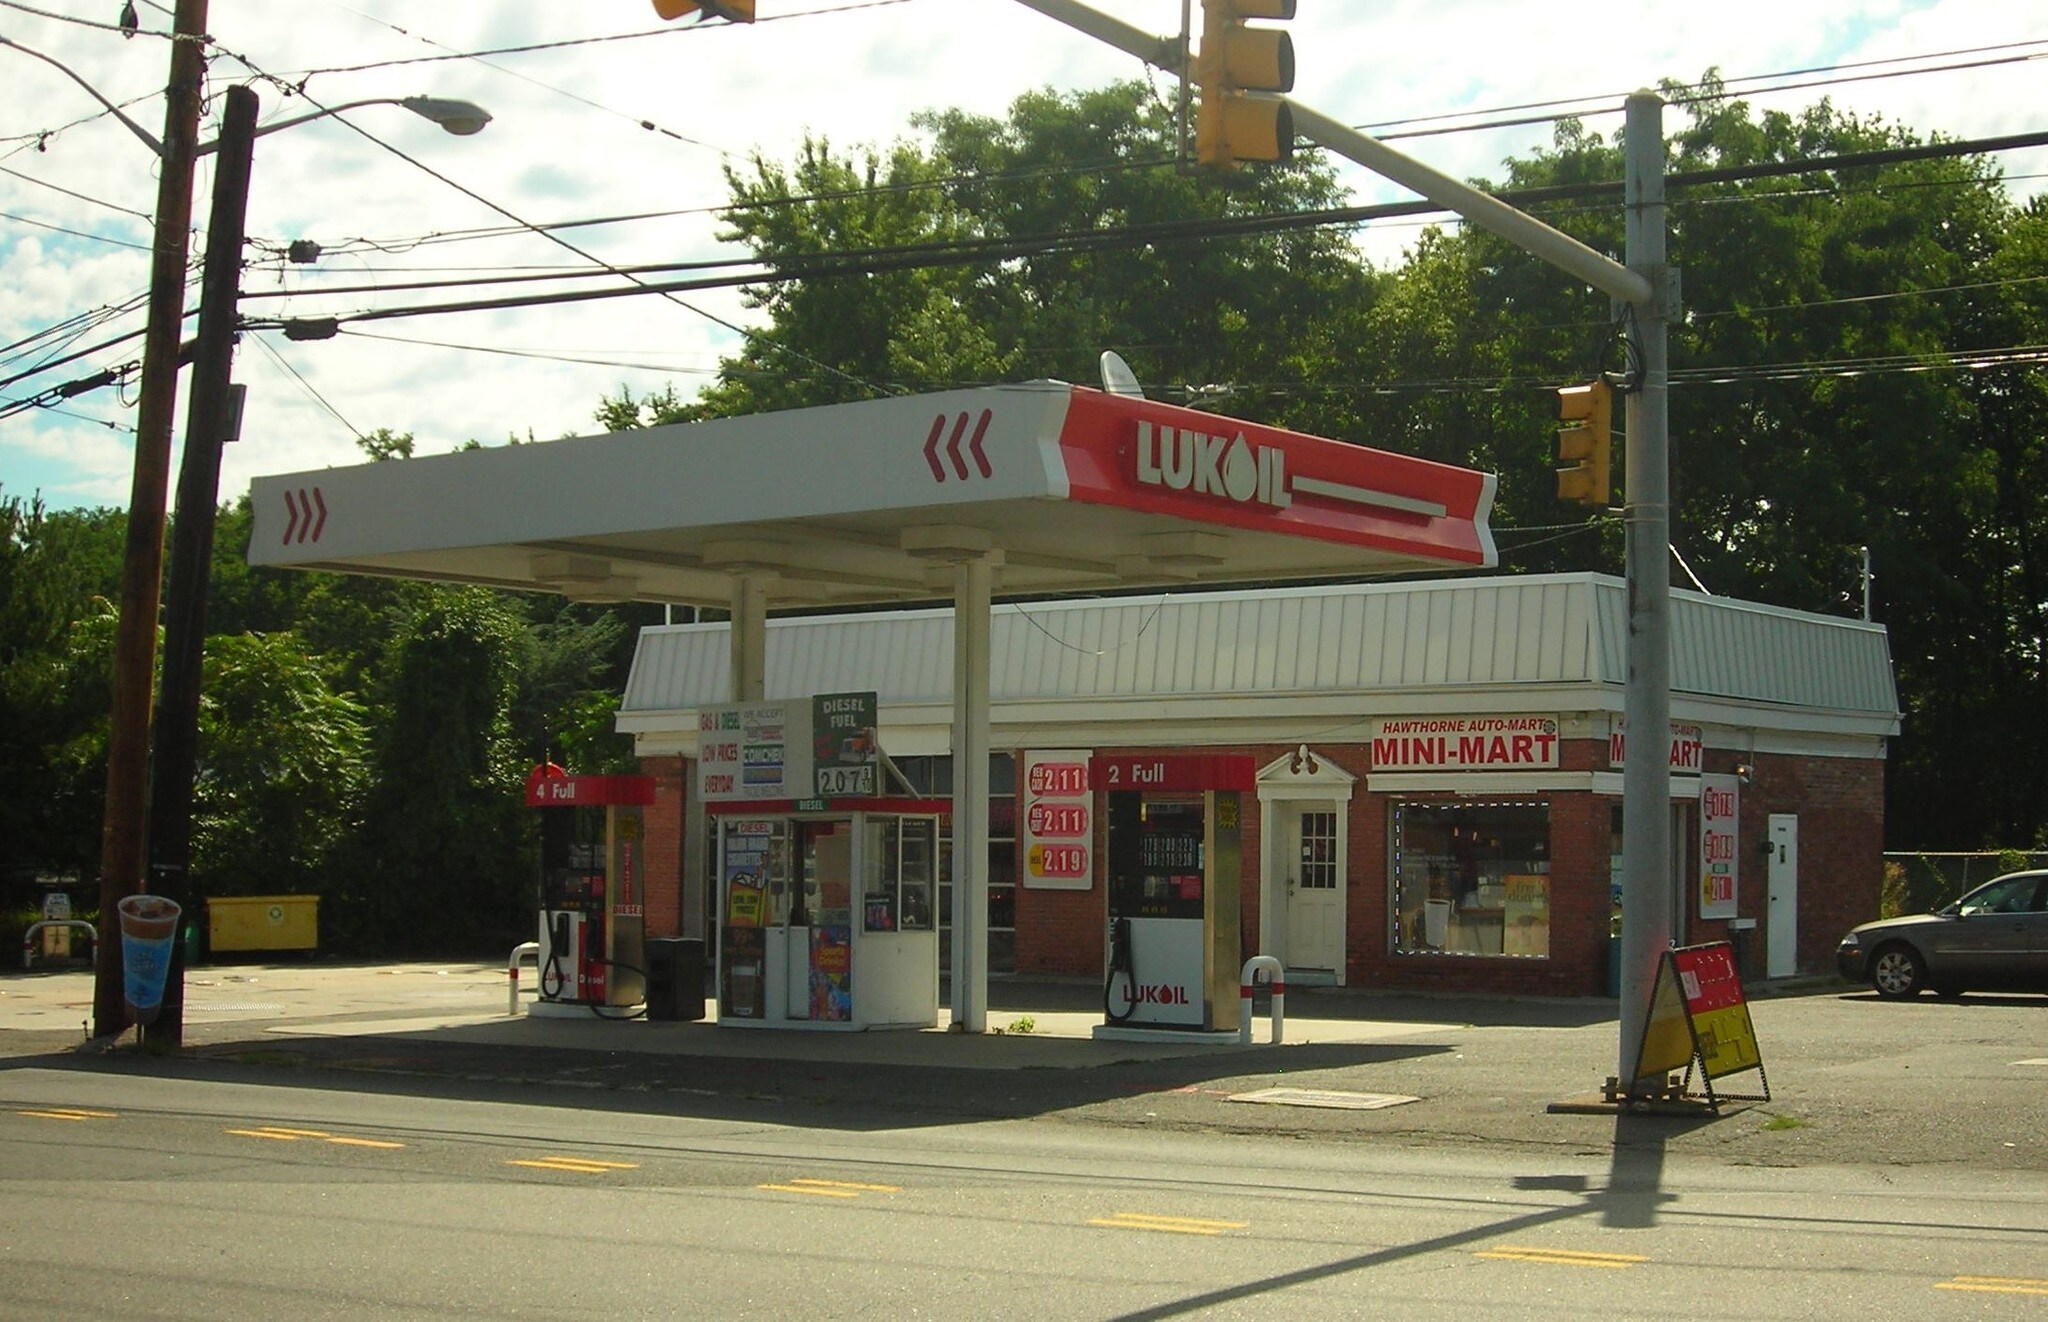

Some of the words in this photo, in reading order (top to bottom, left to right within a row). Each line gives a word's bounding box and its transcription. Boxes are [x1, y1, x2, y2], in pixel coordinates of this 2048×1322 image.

[1136, 420, 1292, 508] LUKOIL
[823, 697, 865, 714] DIESEL
[830, 713, 857, 729] FUEL
[1383, 720, 1465, 734] HAWTHORNE
[1468, 717, 1546, 733] AUTO-MART
[1373, 734, 1556, 766] MINI-MART
[820, 769, 860, 793] 2.07
[1108, 765, 1119, 783] 2
[1132, 763, 1164, 783] Full
[535, 784, 545, 799] 4
[552, 783, 576, 799] Full
[799, 799, 823, 811] DIESEL
[1044, 849, 1080, 871] 2.19
[1122, 983, 1189, 1006] LUKOIL
